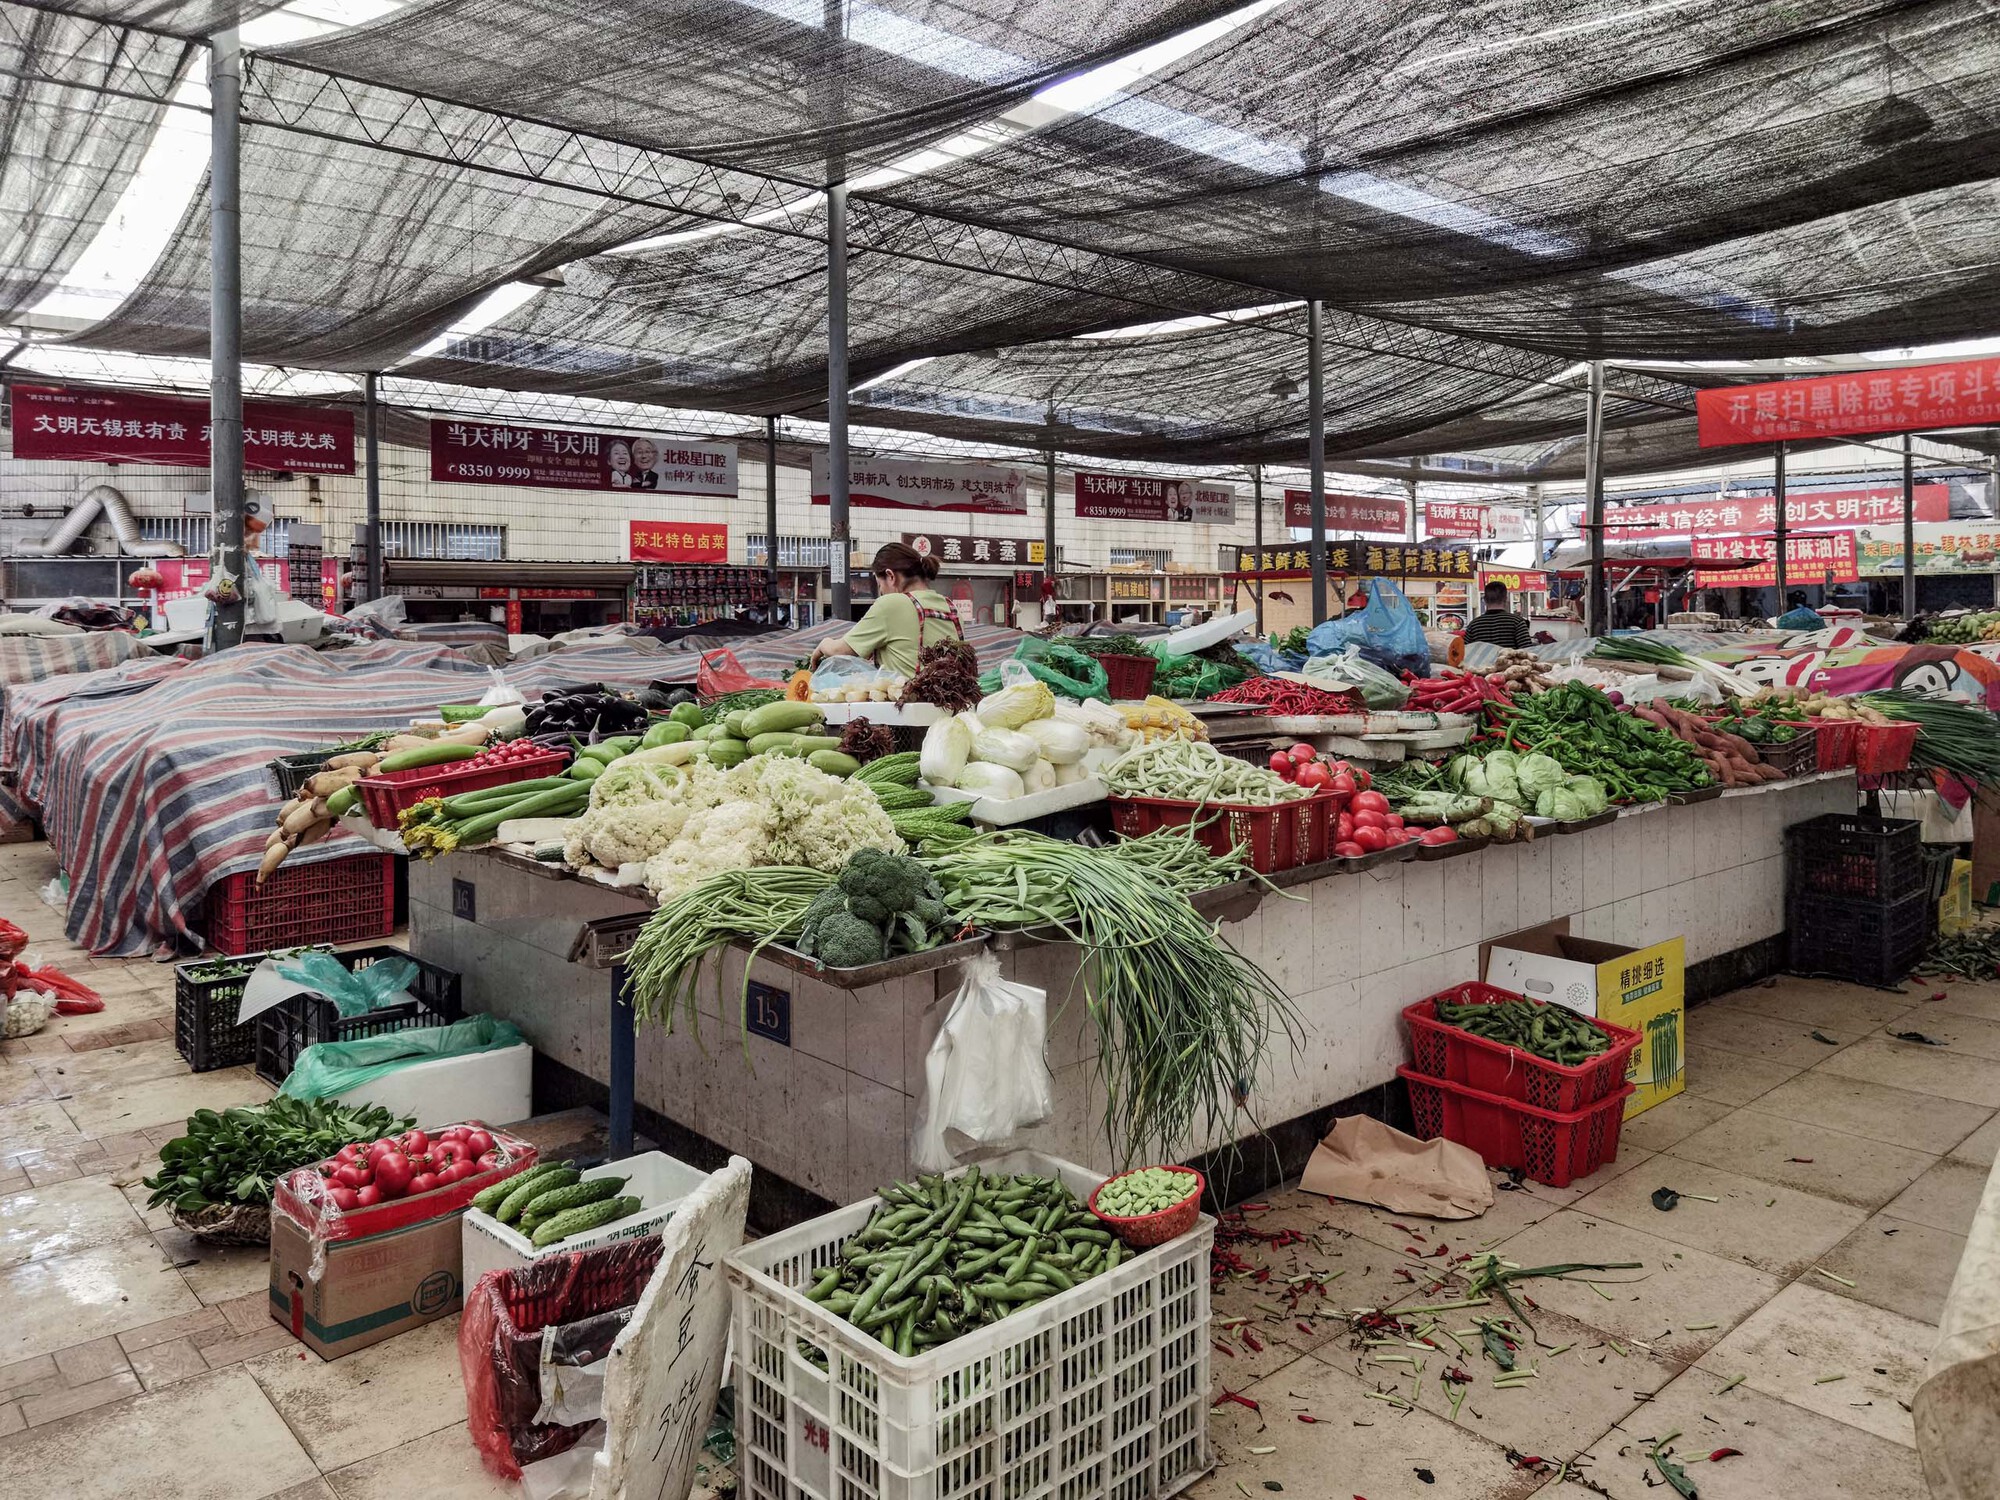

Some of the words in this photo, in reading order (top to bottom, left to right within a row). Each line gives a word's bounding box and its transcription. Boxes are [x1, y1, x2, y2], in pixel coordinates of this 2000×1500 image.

[33, 415, 188, 440] 文明无锡我有责
[200, 425, 337, 451] 无文明我光荣
[448, 424, 533, 450] 当天种牙
[542, 433, 600, 456] 当天用
[664, 449, 726, 468] 北极星口腔
[459, 464, 493, 477] 8350
[497, 466, 531, 479] 9999
[896, 474, 955, 491] 创文明市场
[961, 479, 1015, 495] 建文明城市
[1084, 477, 1127, 495] 当天种牙
[1131, 480, 1162, 498] 当天用
[1089, 506, 1108, 517] 8350
[1108, 507, 1126, 517] 9999
[633, 532, 725, 549] 苏北特色卤菜
[943, 538, 1017, 561] 蒸真蒸
[1620, 956, 1665, 990] 精挑细选
